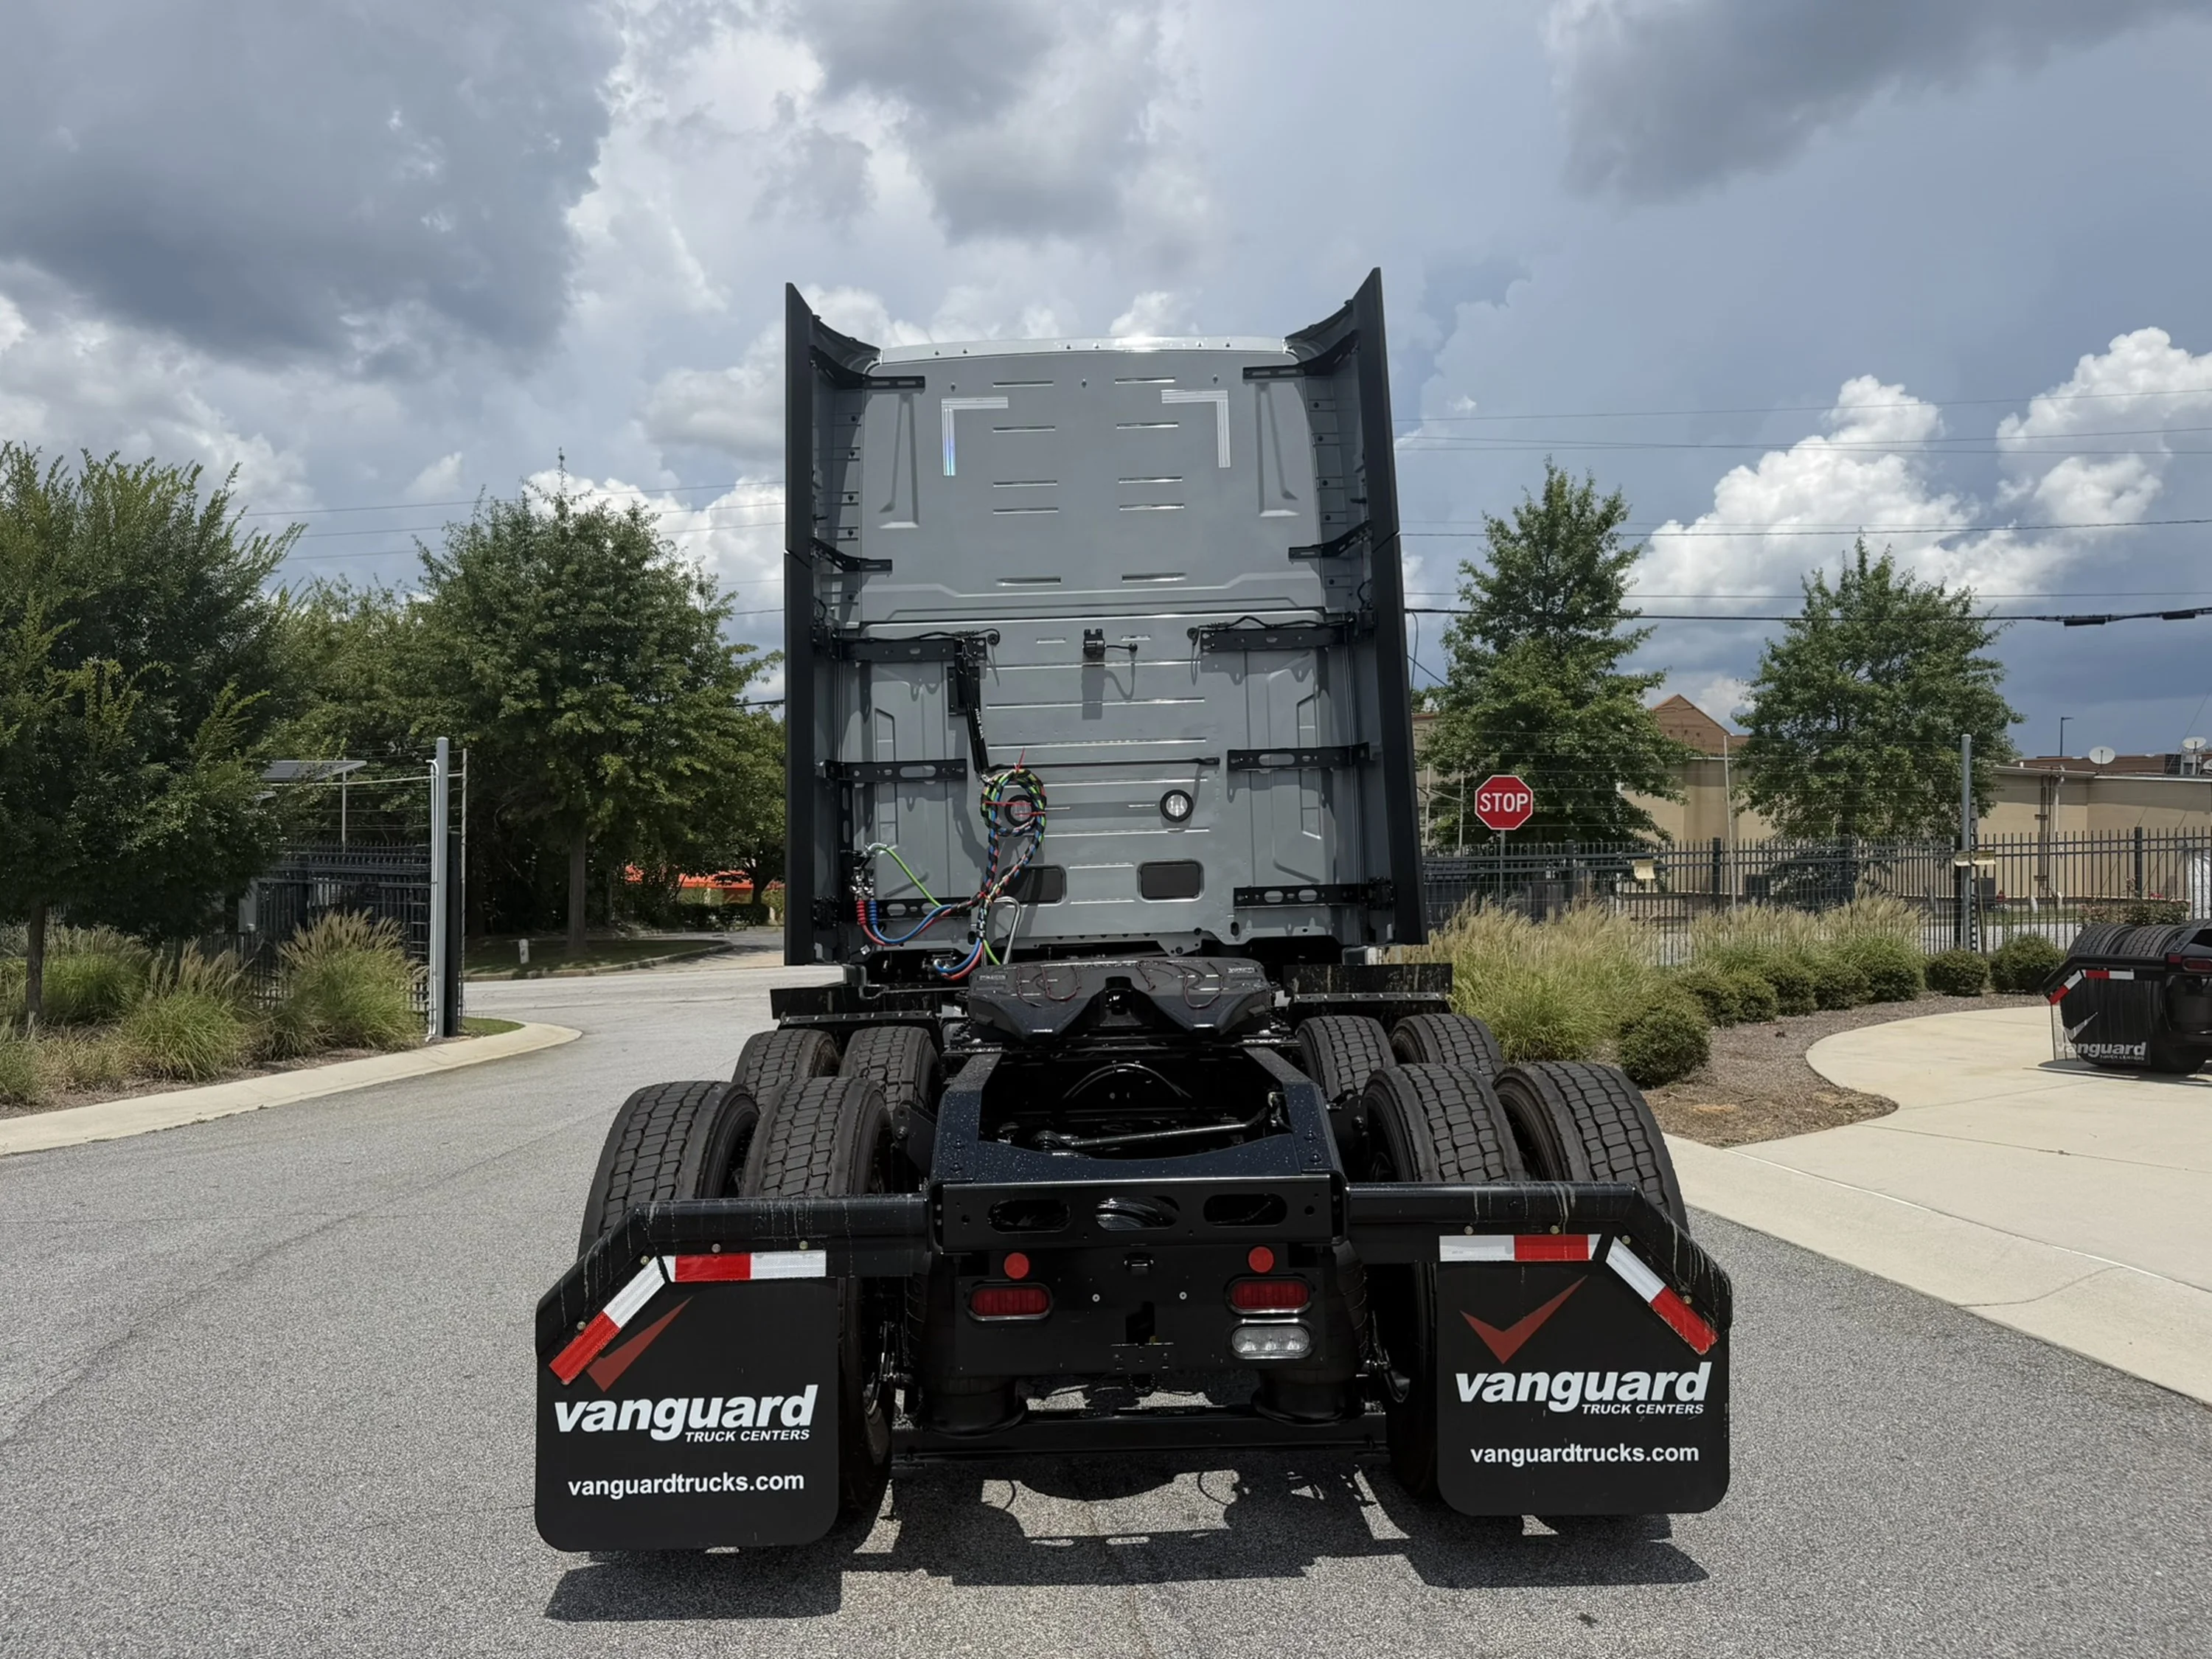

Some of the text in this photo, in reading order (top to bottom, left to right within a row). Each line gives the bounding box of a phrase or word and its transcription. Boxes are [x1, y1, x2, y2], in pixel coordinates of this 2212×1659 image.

[1479, 793, 1528, 813] STOP
[1455, 1362, 1712, 1413] vanguard
[554, 1384, 818, 1441] vanguard
[1582, 1404, 1704, 1414] TRUCK CENTERS
[684, 1429, 810, 1443] TRUCK CENTERS
[1470, 1443, 1700, 1468] vanguardtrucks.com
[567, 1472, 805, 1500] vanguardtrucks.com
